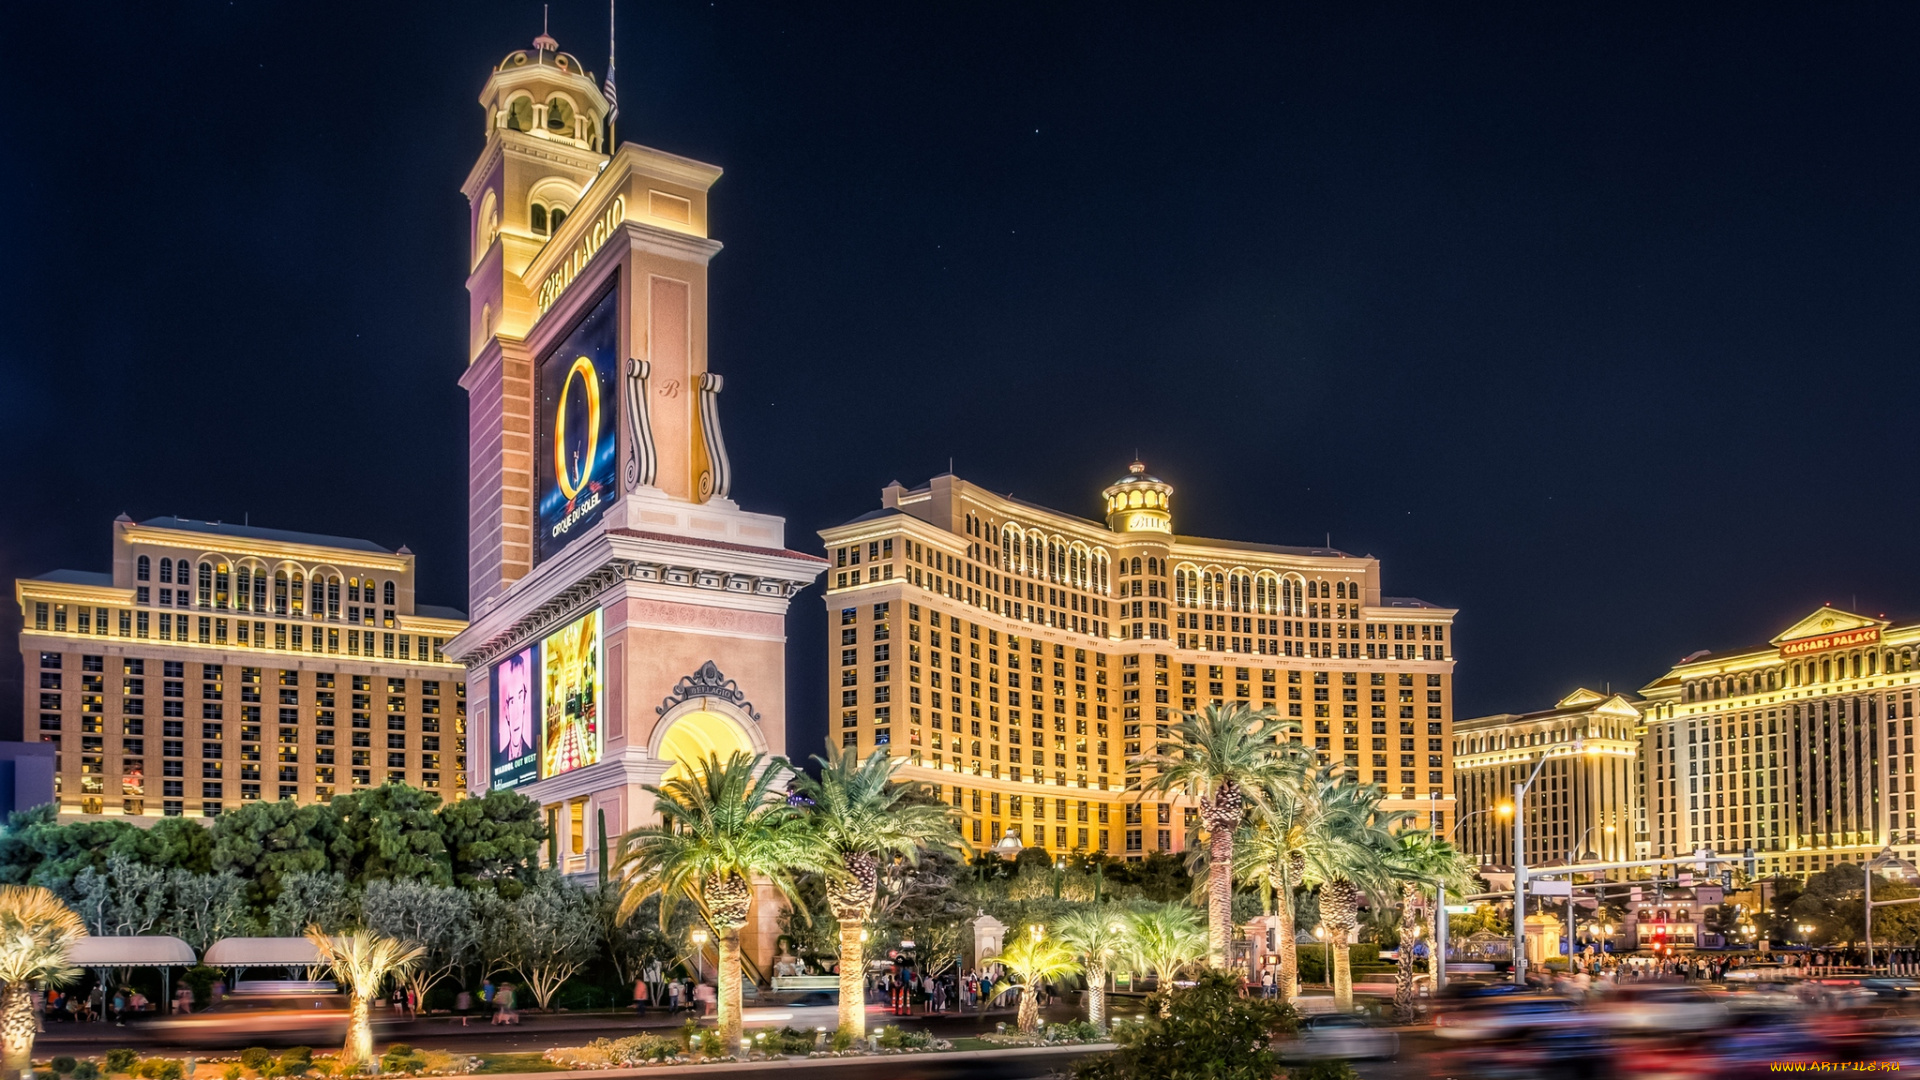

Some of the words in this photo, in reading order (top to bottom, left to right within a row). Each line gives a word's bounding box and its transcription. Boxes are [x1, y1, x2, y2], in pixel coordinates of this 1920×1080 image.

[538, 194, 626, 314] BELLAGIO
[553, 514, 572, 537] CIRQUE
[572, 506, 581, 523] DU
[581, 492, 602, 516] SOLEIL
[1783, 638, 1831, 655] CAESARS
[1833, 630, 1877, 647] PALACE
[691, 685, 732, 697] BELLAGIO
